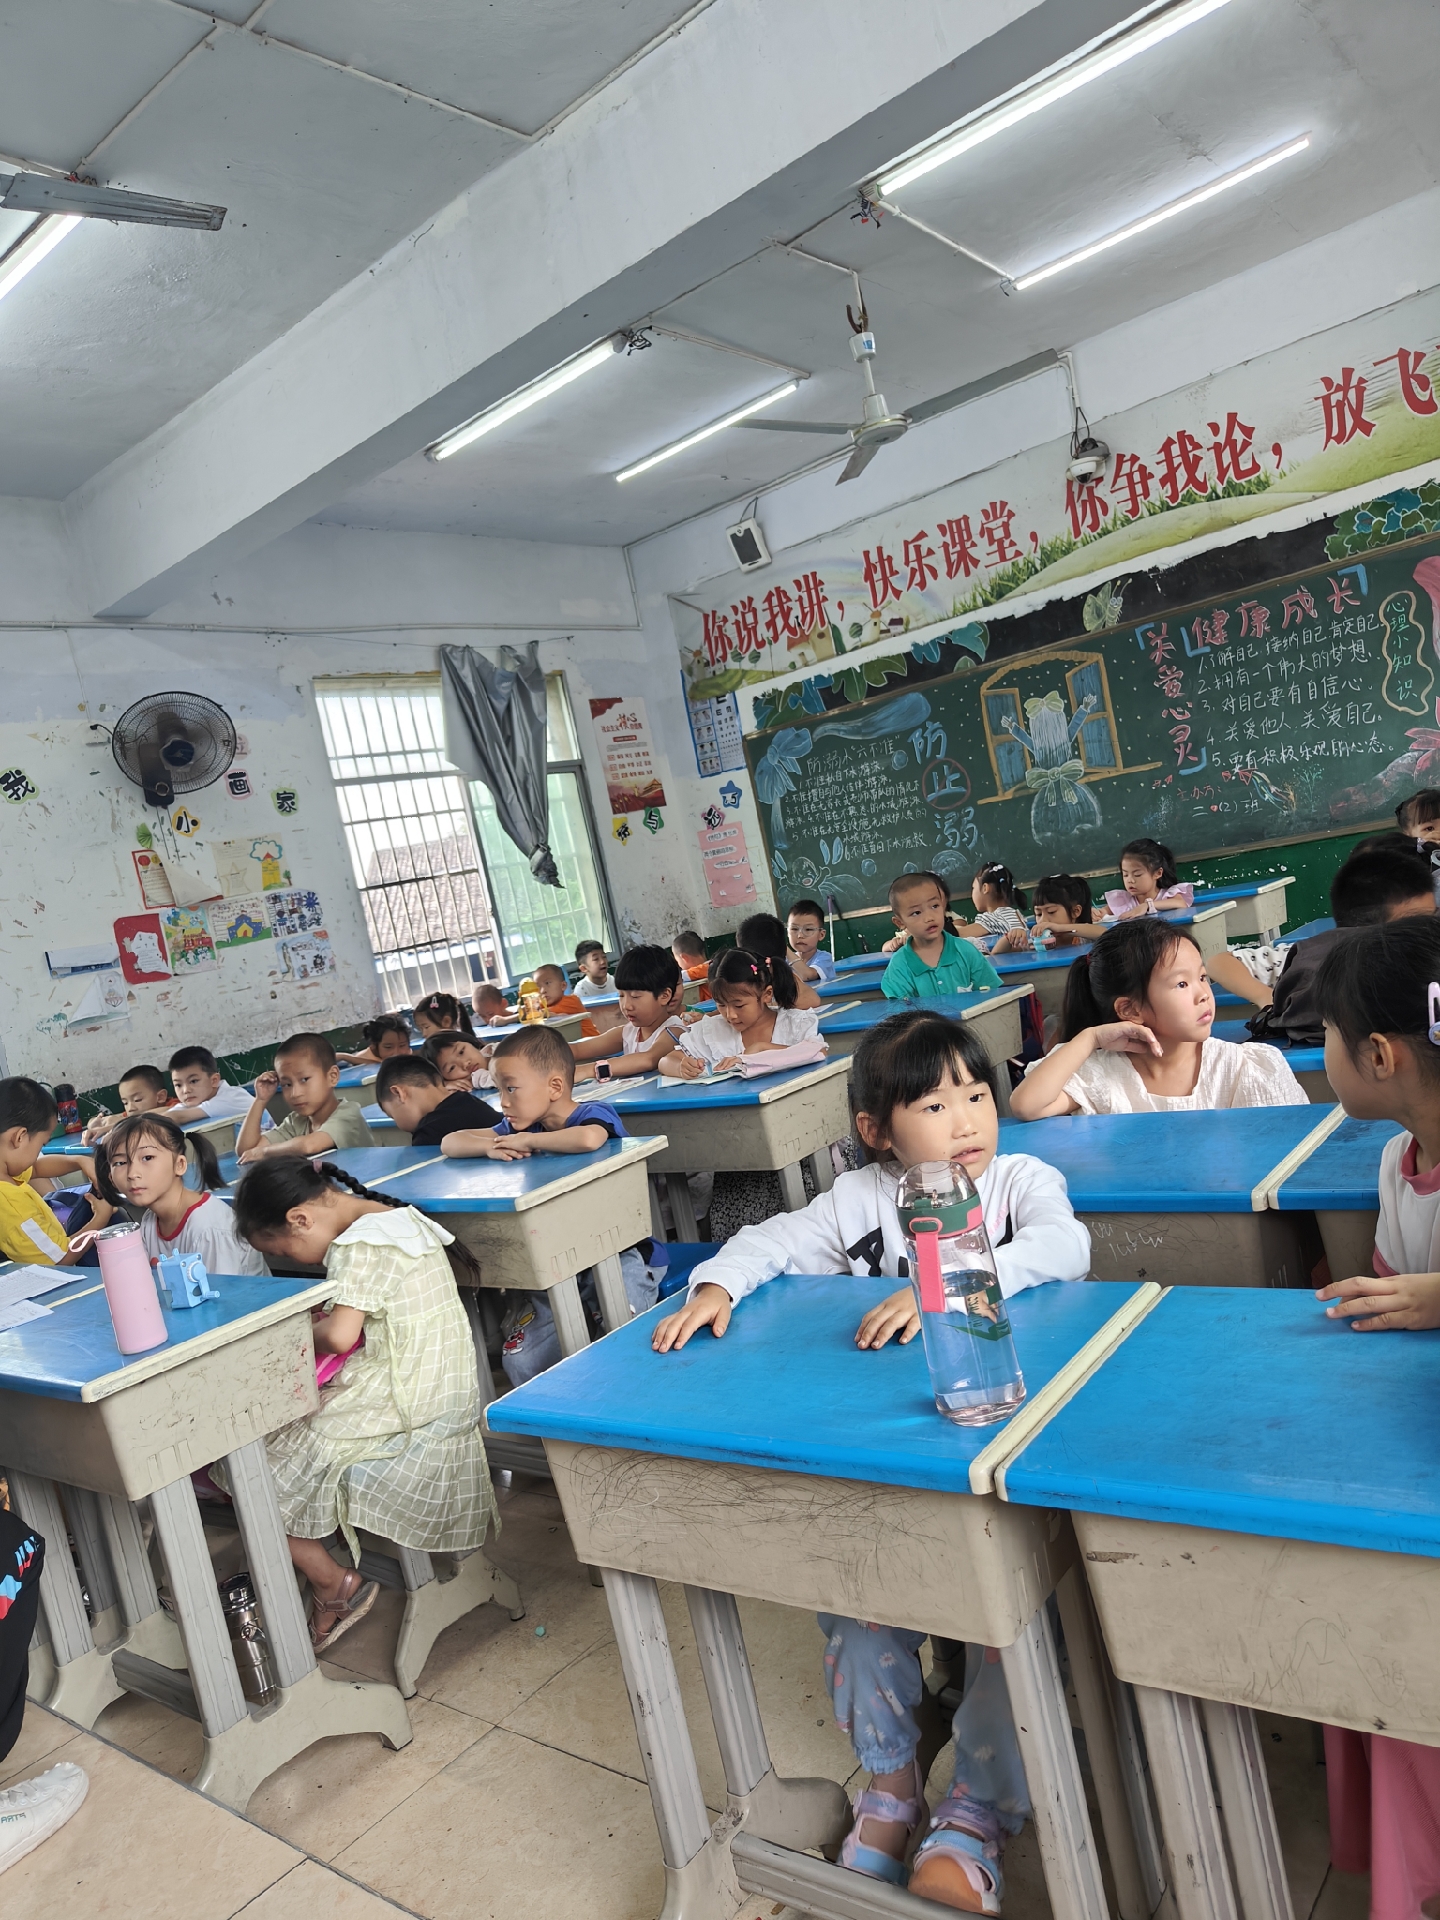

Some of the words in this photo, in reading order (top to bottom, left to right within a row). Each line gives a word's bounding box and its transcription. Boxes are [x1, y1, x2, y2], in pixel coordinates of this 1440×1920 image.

[1191, 577, 1361, 647] 健康成长
[1386, 598, 1418, 701] 心理小知识
[1146, 621, 1198, 767] 关爱心灵
[176, 810, 199, 834] 小
[227, 772, 251, 796] 画
[276, 791, 298, 813] 家
